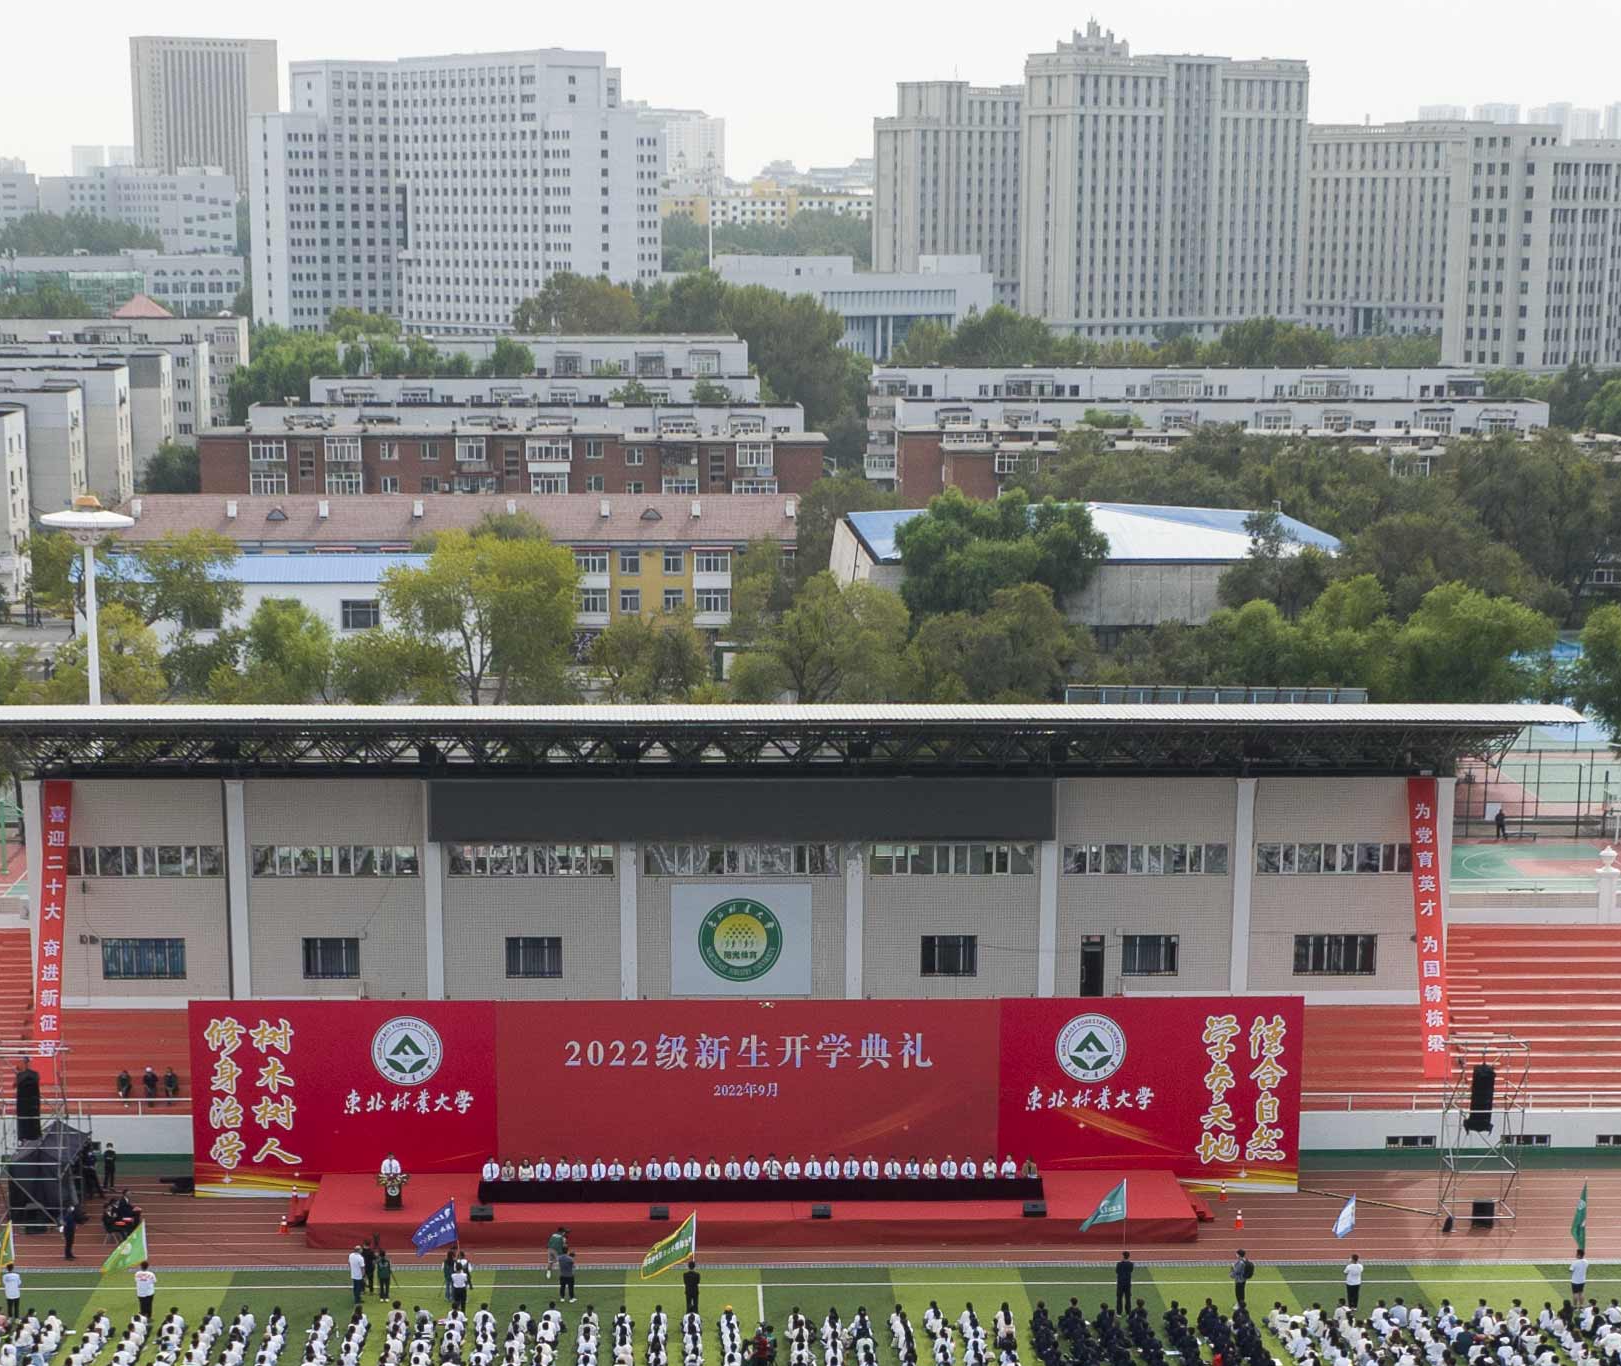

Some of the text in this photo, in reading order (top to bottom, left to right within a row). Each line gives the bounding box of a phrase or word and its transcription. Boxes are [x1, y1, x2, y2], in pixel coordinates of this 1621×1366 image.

[38, 805, 67, 1057] 喜迎二十大 奋进新征程
[1415, 803, 1446, 1052] 为党育英才 为国铸栋梁
[204, 1017, 246, 1169] 修身治学
[249, 1018, 302, 1165] 树木树人
[564, 1032, 934, 1071] 2022级新生开学典礼
[713, 1082, 778, 1099] 2022年9月
[1195, 1014, 1241, 1165] 学参天地
[1246, 1015, 1288, 1161] 德合自然
